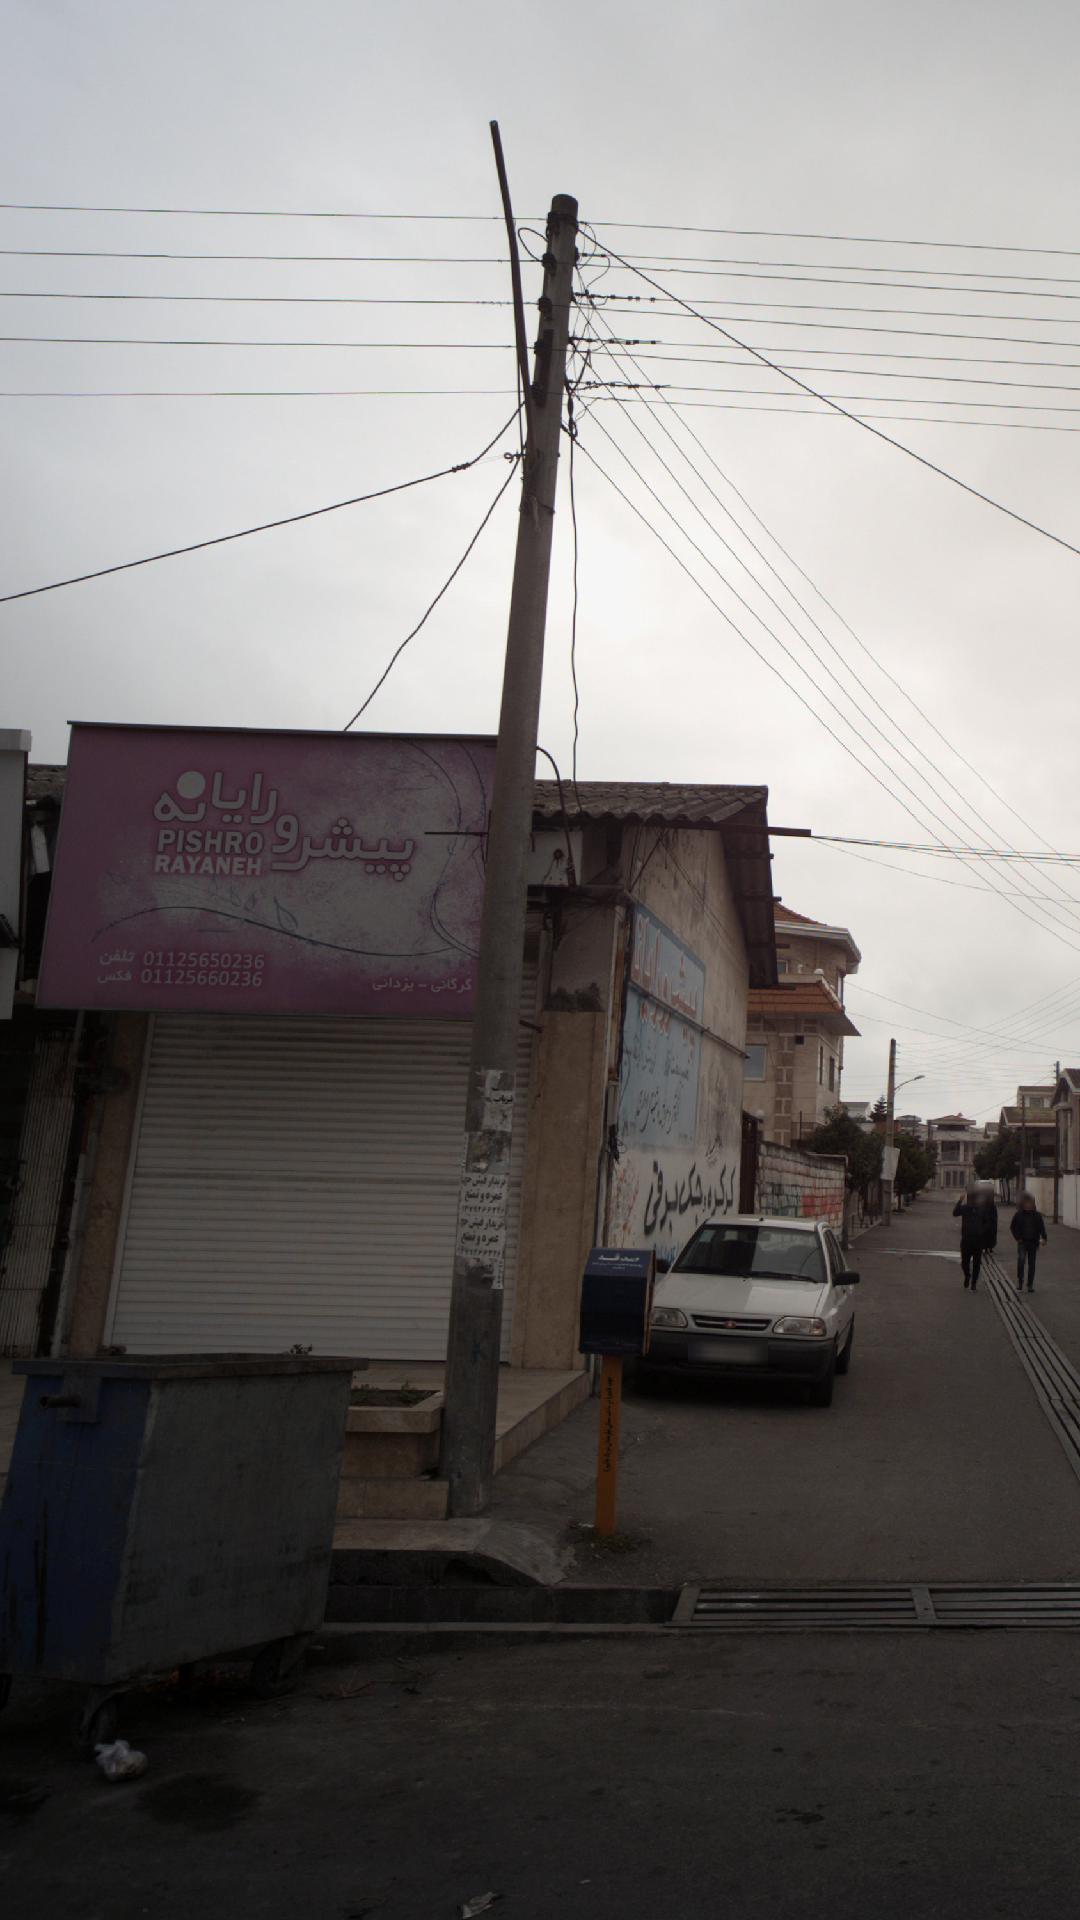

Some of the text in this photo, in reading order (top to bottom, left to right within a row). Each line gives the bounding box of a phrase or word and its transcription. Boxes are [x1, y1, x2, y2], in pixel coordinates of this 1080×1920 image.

[154, 770, 279, 825] رایانه
[157, 829, 264, 854] PISHRO
[271, 818, 415, 881] پیشرو
[154, 855, 262, 876] RAYANEH
[99, 949, 265, 970] تلفن 01125650236
[96, 969, 263, 987] فکس 01125660236
[644, 1160, 678, 1236] برقی
